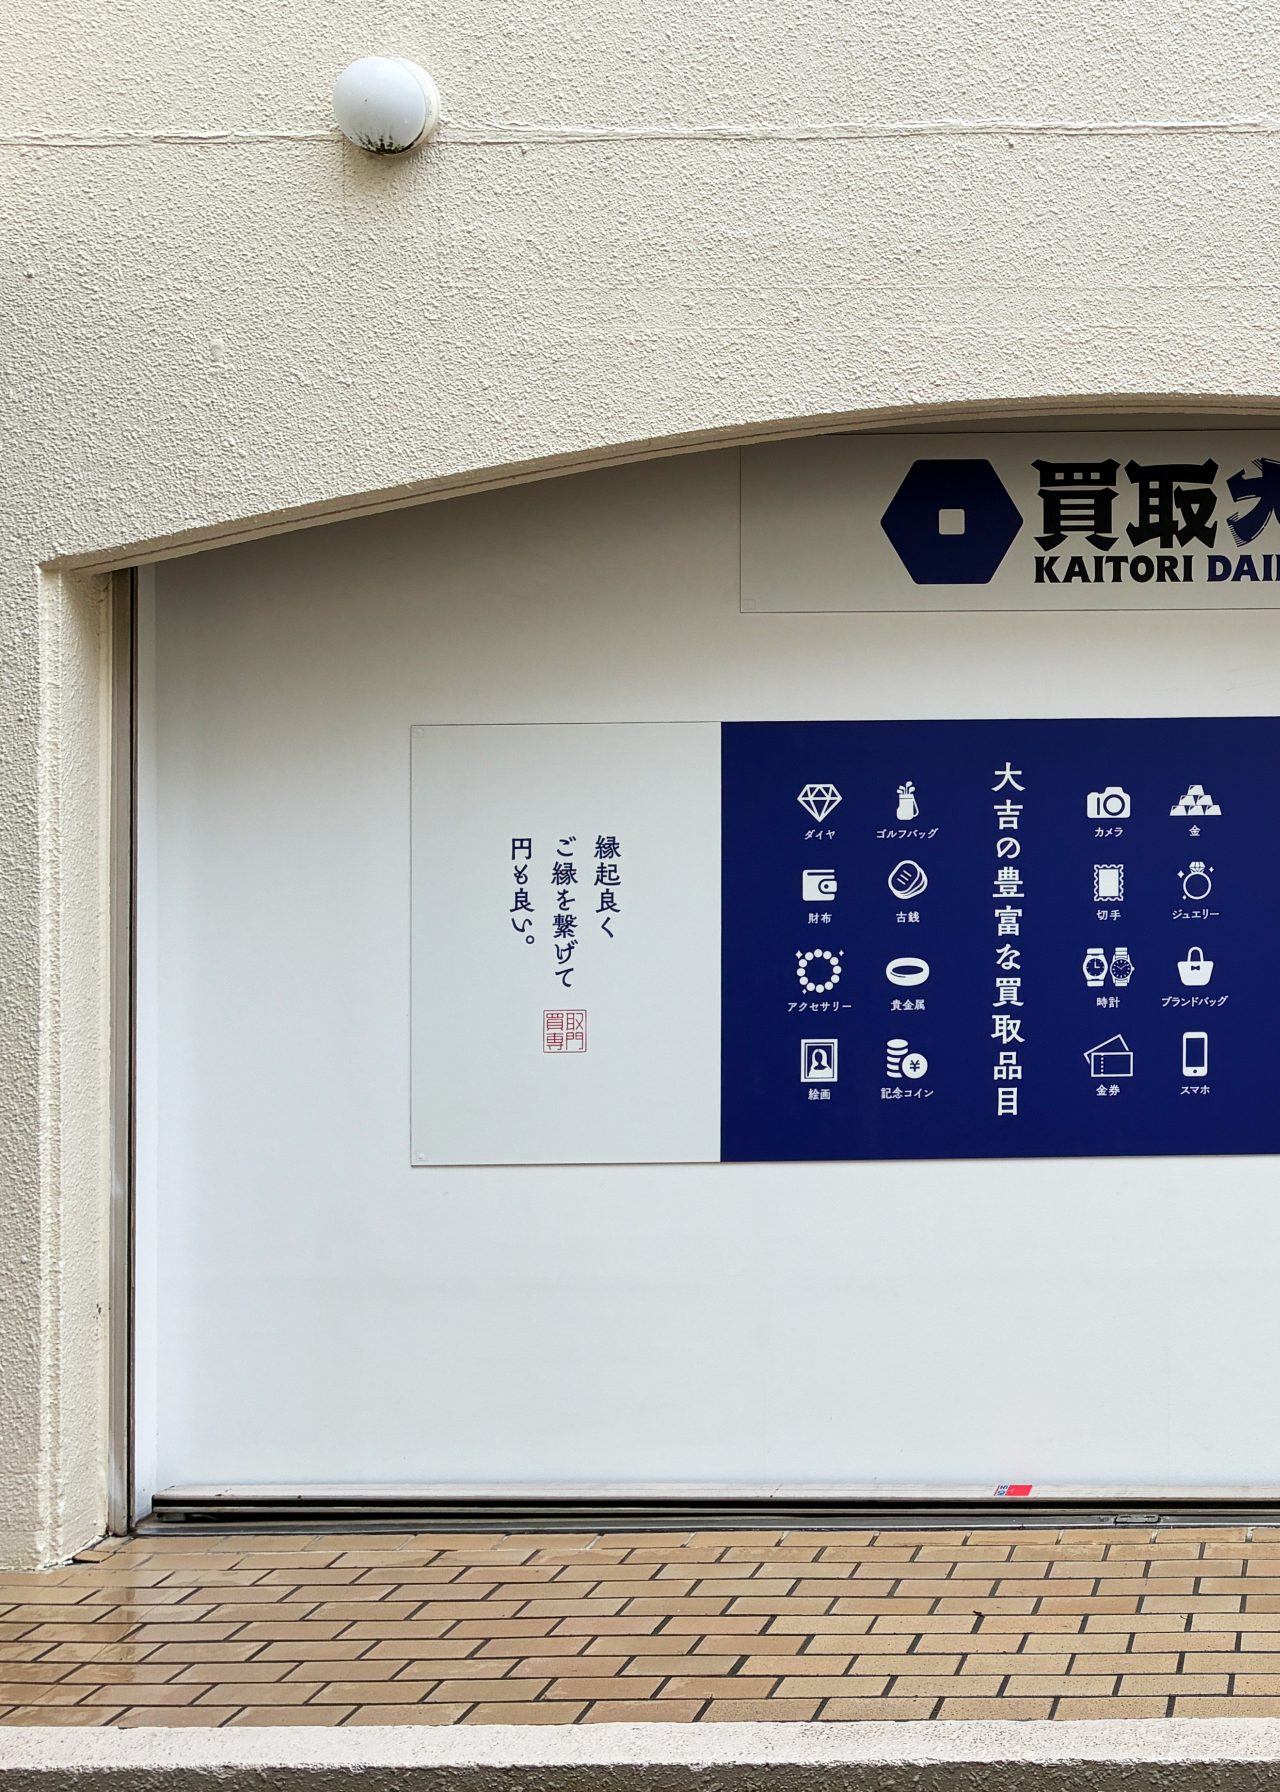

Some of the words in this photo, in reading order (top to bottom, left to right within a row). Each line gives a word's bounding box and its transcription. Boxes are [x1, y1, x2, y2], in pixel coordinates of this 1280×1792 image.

[1033, 554, 1194, 584] KAITORI
[804, 829, 836, 841] ダイヤ
[876, 827, 939, 840] ゴルフバッグ
[1094, 826, 1124, 838] カメラ
[1188, 824, 1201, 837] 金
[509, 837, 536, 945] 円も良い。
[594, 835, 622, 938] 縁起良く
[551, 836, 579, 988] ご縁を繋げて
[807, 911, 833, 925] 財布
[895, 910, 920, 924] 古銭
[1096, 909, 1122, 921] 切手
[1171, 908, 1220, 920] ジュエリー
[991, 762, 1026, 1116] 大吉の豊富な買取品目
[787, 1000, 852, 1013] アクセサリー
[890, 998, 926, 1012] 貴金属
[1096, 996, 1121, 1009] 時計
[1161, 995, 1229, 1008] ブランドバッグ
[807, 1087, 831, 1101] 絵画
[880, 1086, 934, 1100] 記念コイン
[1095, 1083, 1121, 1097] 金券
[1179, 1084, 1211, 1095] スマホ
